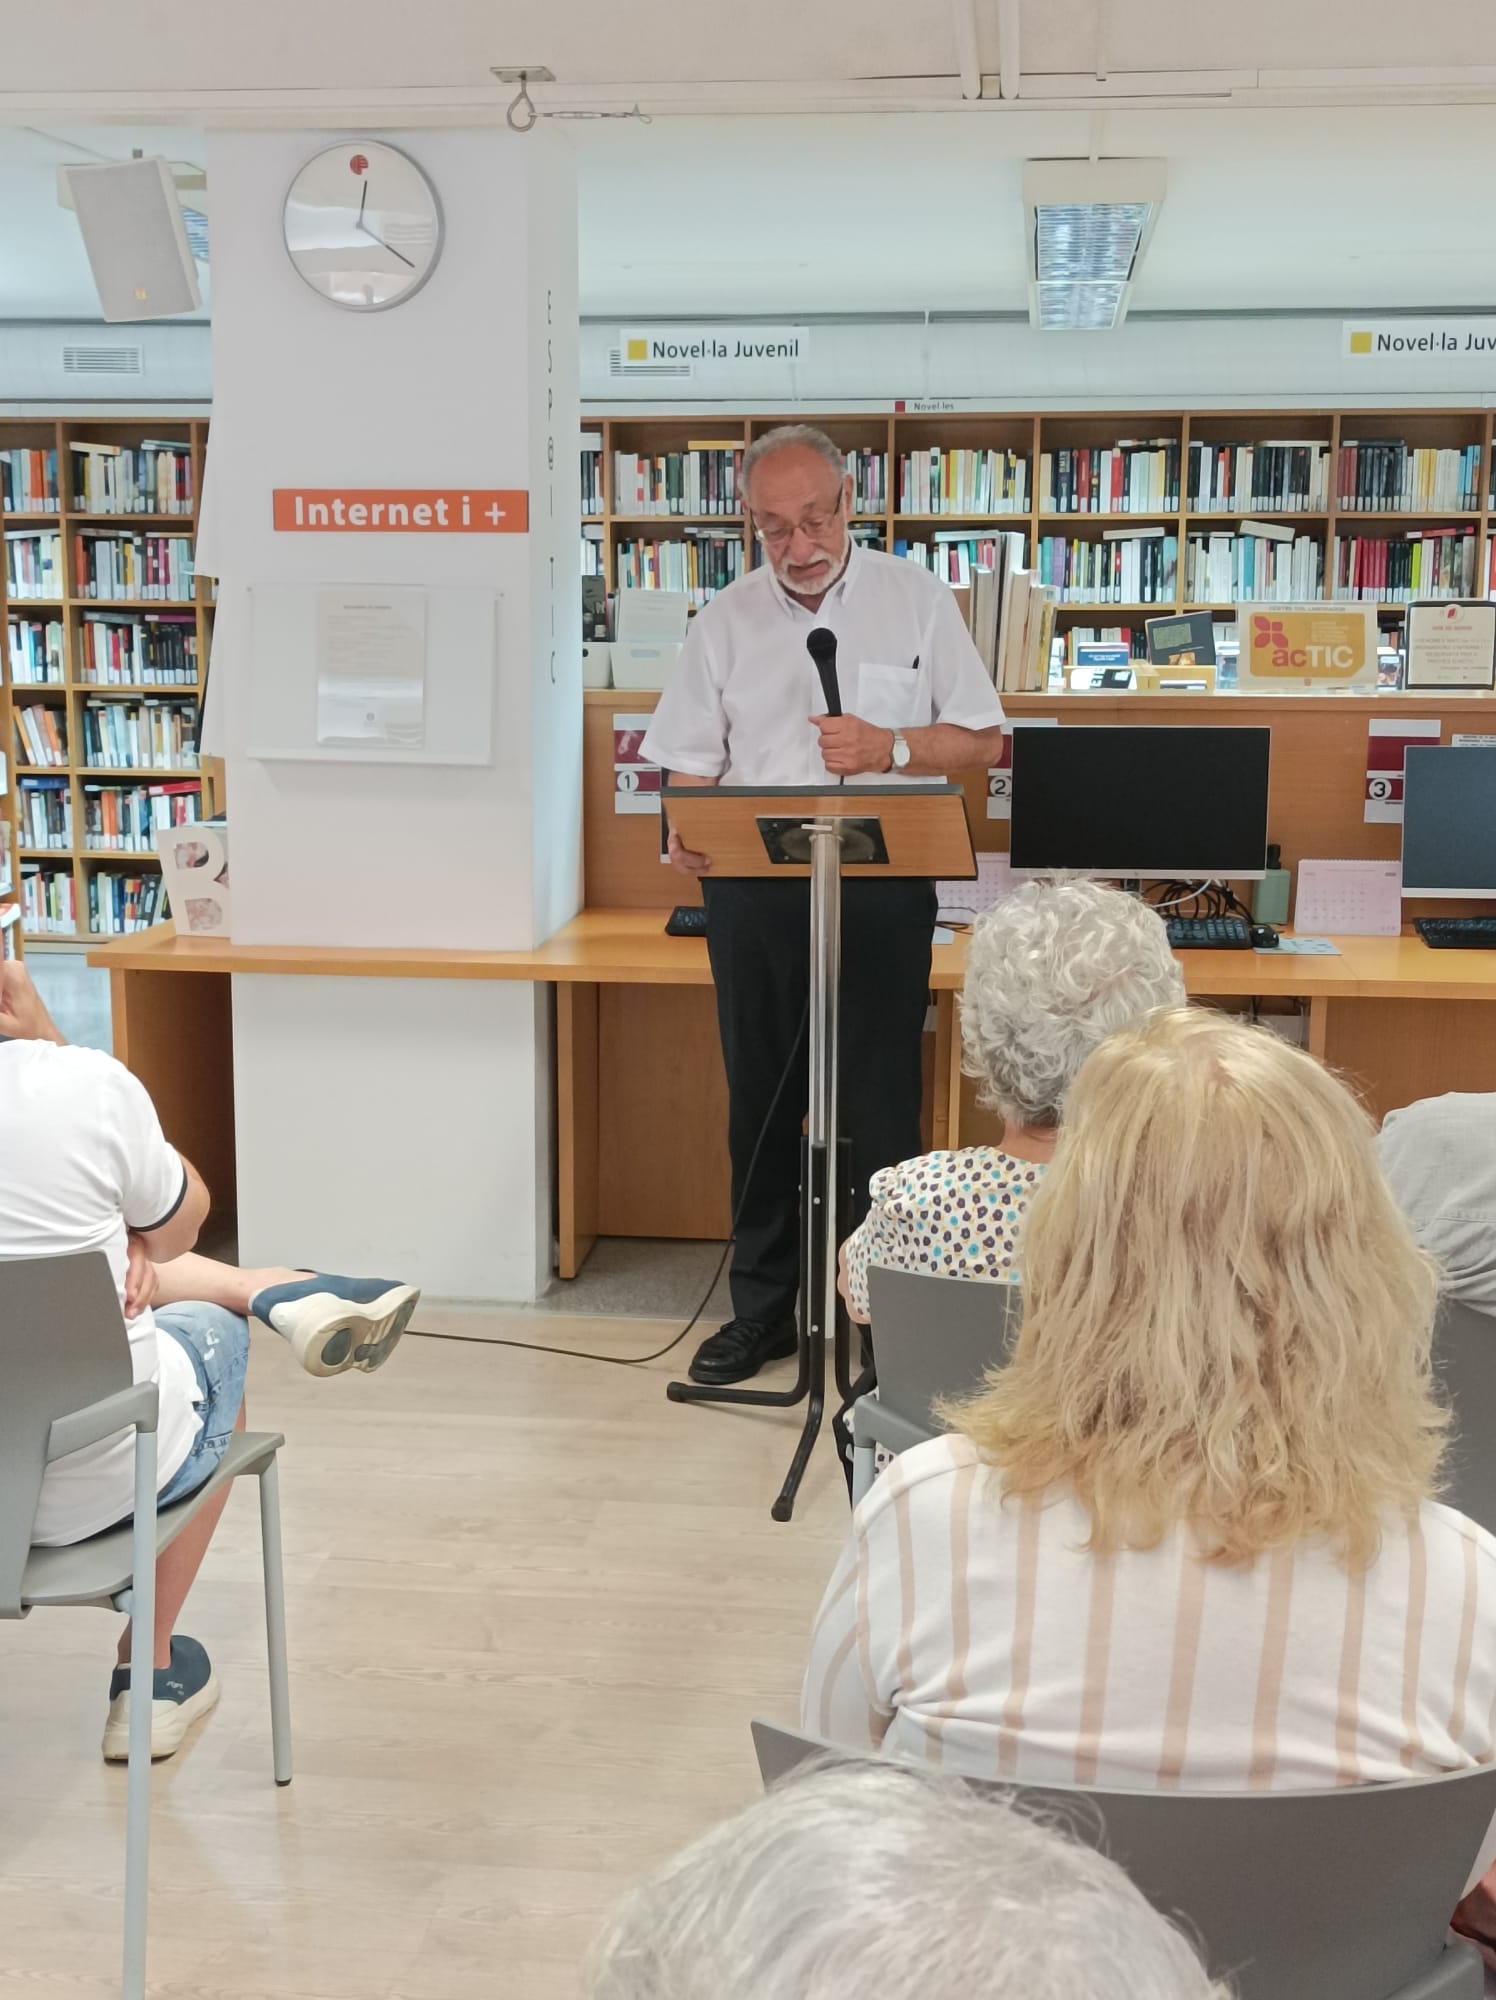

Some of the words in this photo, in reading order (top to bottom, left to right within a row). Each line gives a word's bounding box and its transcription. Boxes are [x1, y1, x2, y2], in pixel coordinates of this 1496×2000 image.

[653, 340, 727, 358] Novel·la
[734, 339, 798, 358] Juvenil
[1377, 332, 1457, 351] Novel·la
[295, 496, 448, 526] Internet
[462, 495, 471, 526] i
[484, 502, 506, 526] +
[1272, 645, 1353, 668] acTIC
[624, 774, 630, 789] 1
[995, 779, 1006, 795] 2
[1374, 781, 1386, 797] 3
